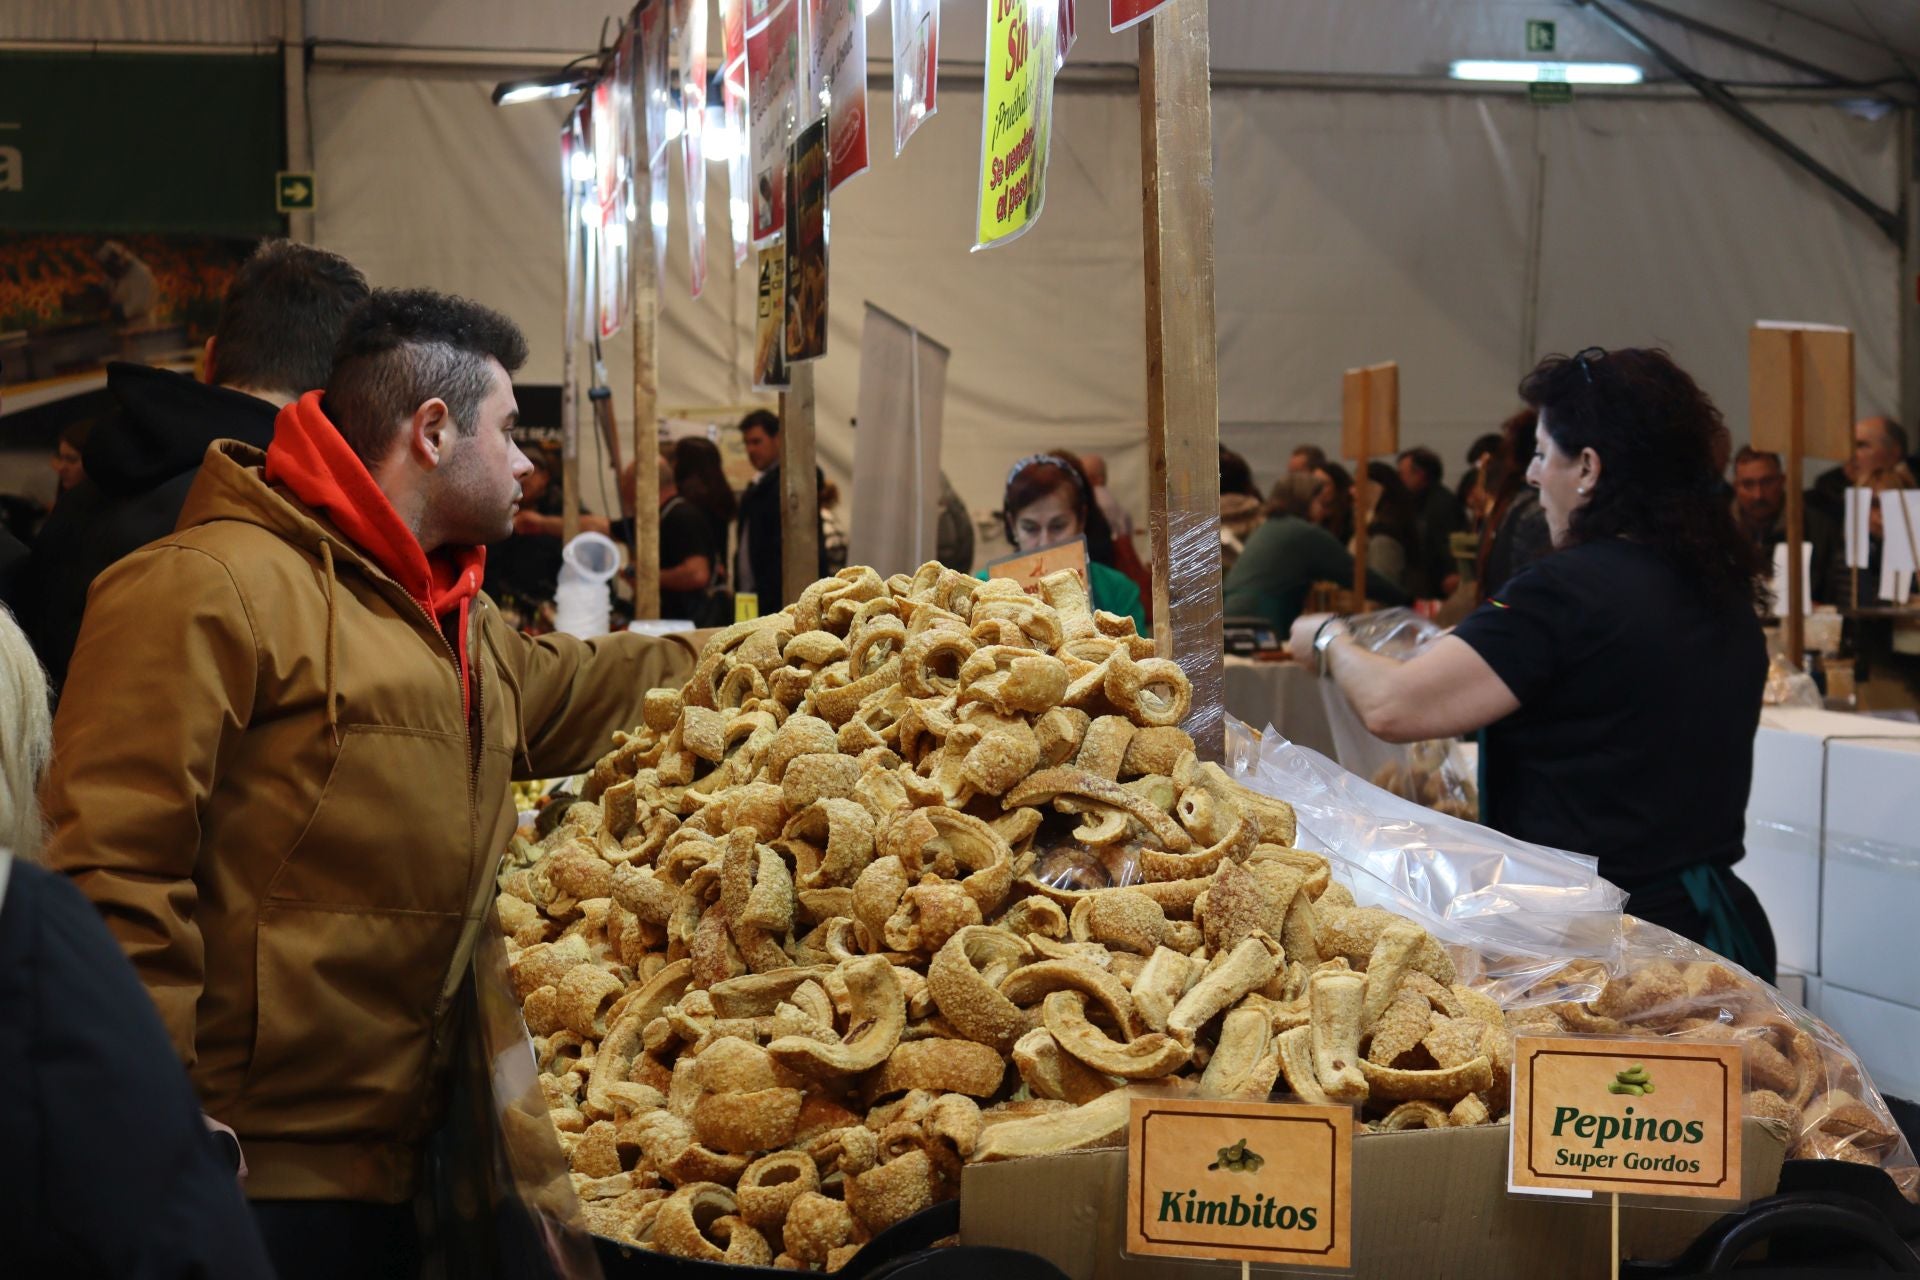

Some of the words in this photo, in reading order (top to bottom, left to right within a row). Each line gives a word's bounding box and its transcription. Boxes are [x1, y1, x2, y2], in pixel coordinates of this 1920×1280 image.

[1551, 1106, 1704, 1149] Pepinos
[1554, 1148, 1618, 1172] Super
[1623, 1152, 1700, 1174] Gordos
[1157, 1188, 1318, 1231] Kimbitos
